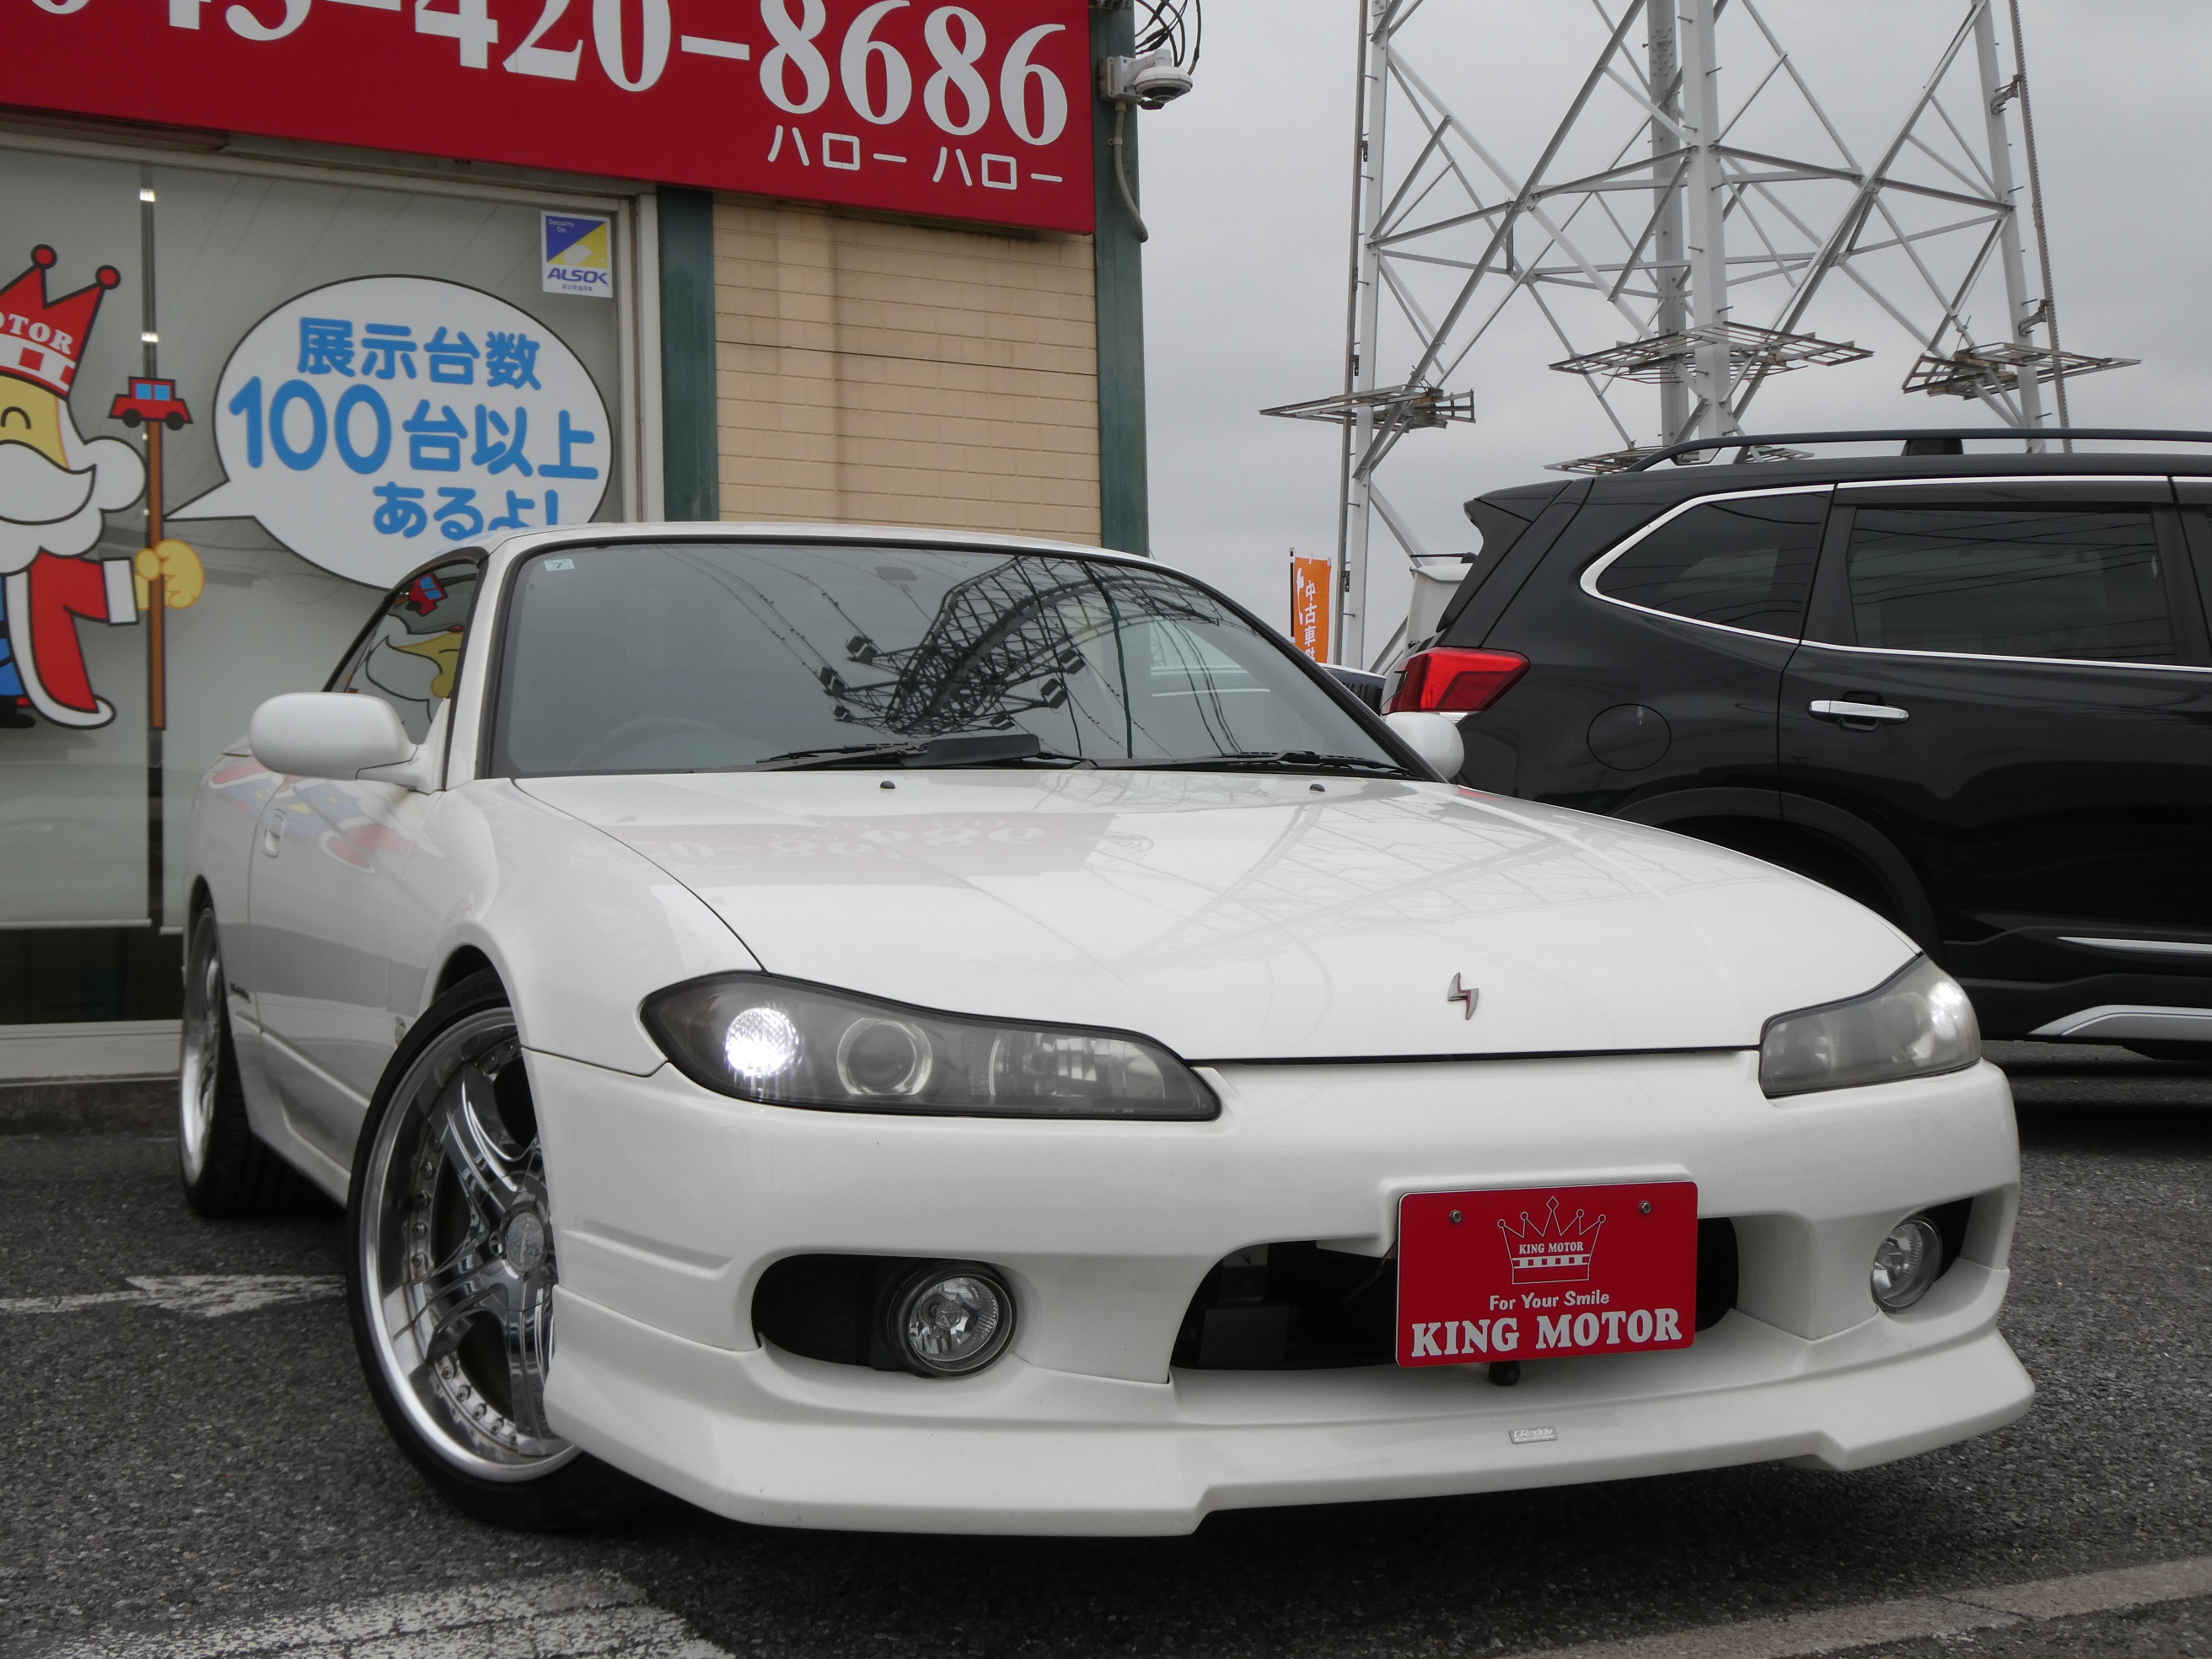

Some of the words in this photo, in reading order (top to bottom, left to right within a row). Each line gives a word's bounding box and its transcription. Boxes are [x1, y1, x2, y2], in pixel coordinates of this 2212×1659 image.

[767, 124, 908, 170] ハロー
[932, 147, 1064, 191] ハロー
[549, 218, 574, 228] Security
[547, 267, 608, 285] ALSOK
[0, 311, 72, 355] TOR
[298, 316, 542, 391] 展示台数
[228, 375, 599, 481] 100台以上
[1519, 1243, 1545, 1254] KING
[1548, 1241, 1584, 1254] MOTOR
[1490, 1295, 1516, 1311] For
[1521, 1291, 1560, 1309] Your
[1564, 1289, 1610, 1307] Smile
[1411, 1318, 1520, 1357] KING
[1536, 1307, 1683, 1350] MOTOR
